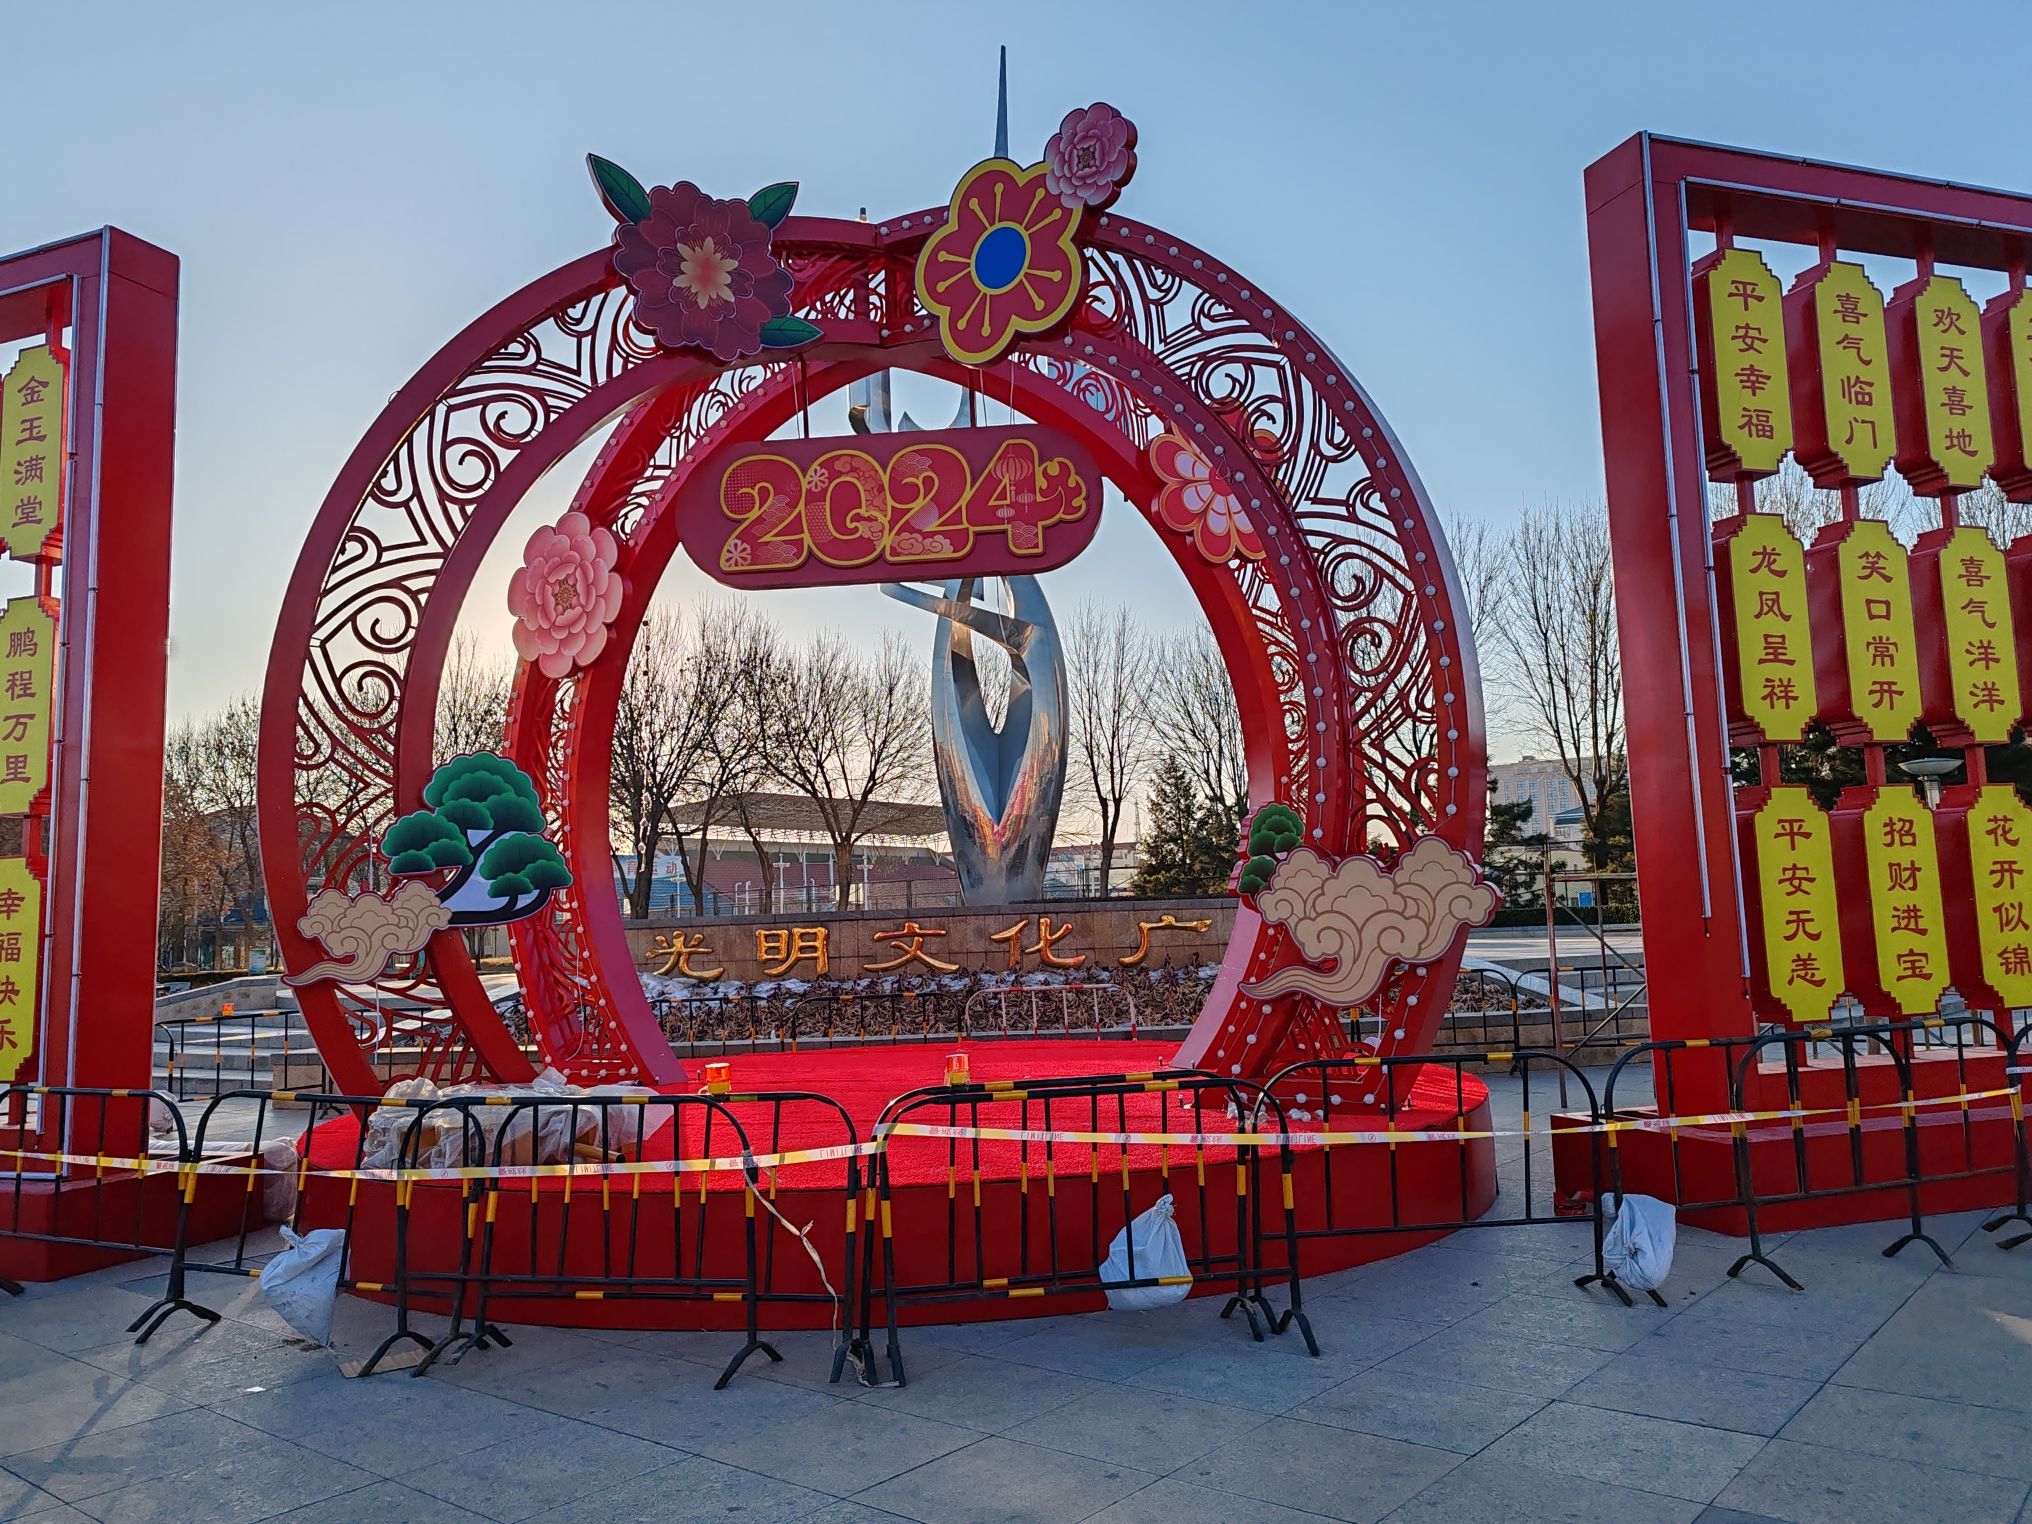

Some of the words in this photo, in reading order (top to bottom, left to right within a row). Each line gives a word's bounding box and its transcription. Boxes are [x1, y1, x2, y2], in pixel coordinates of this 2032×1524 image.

[1727, 279, 1775, 440] 平安幸福
[1832, 292, 1879, 450] 喜气临门
[1932, 306, 1979, 458] 欢天喜地
[11, 375, 50, 528] 金玉满堂
[719, 438, 1088, 574] 2024
[0, 626, 38, 784] 鹏程万里
[1748, 545, 1800, 710] 龙凤呈祥
[1857, 550, 1904, 711] 笑口常开
[1957, 556, 2006, 713] 喜气洋洋
[645, 914, 1213, 981] 光明文化广
[1773, 818, 1827, 988] 平安无恙
[1882, 816, 1934, 983] 招财进宝
[1985, 814, 2032, 977] 花开似锦
